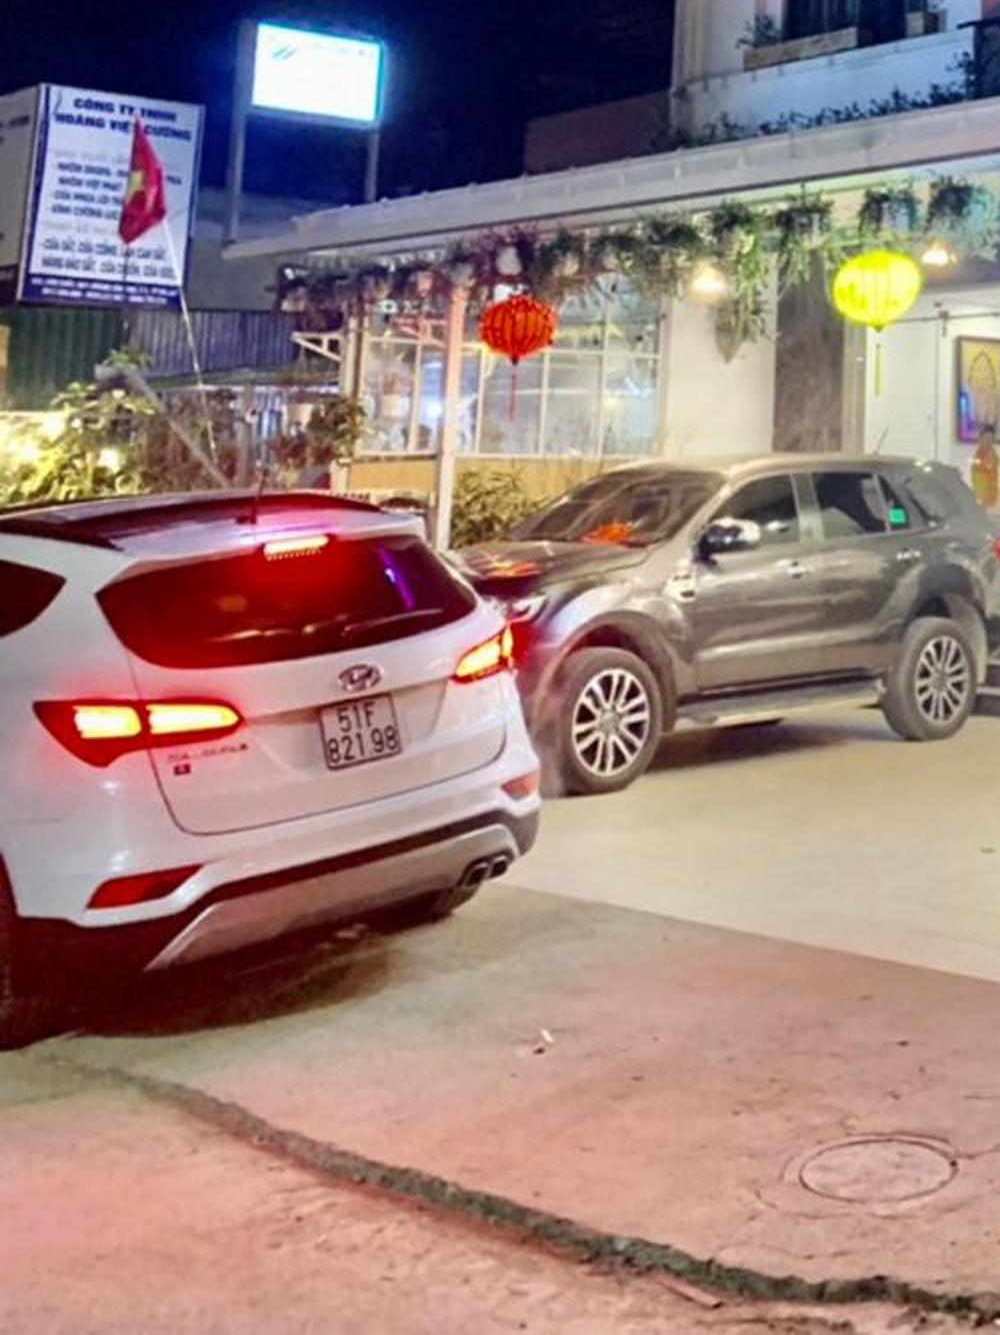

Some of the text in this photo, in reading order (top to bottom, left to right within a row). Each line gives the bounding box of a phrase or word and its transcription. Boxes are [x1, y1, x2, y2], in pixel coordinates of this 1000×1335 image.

[73, 97, 115, 113] CÔNG
[119, 104, 136, 116] TY
[55, 113, 106, 129] HOÀNG
[109, 119, 138, 134] VIỆ
[336, 700, 375, 733] 51F
